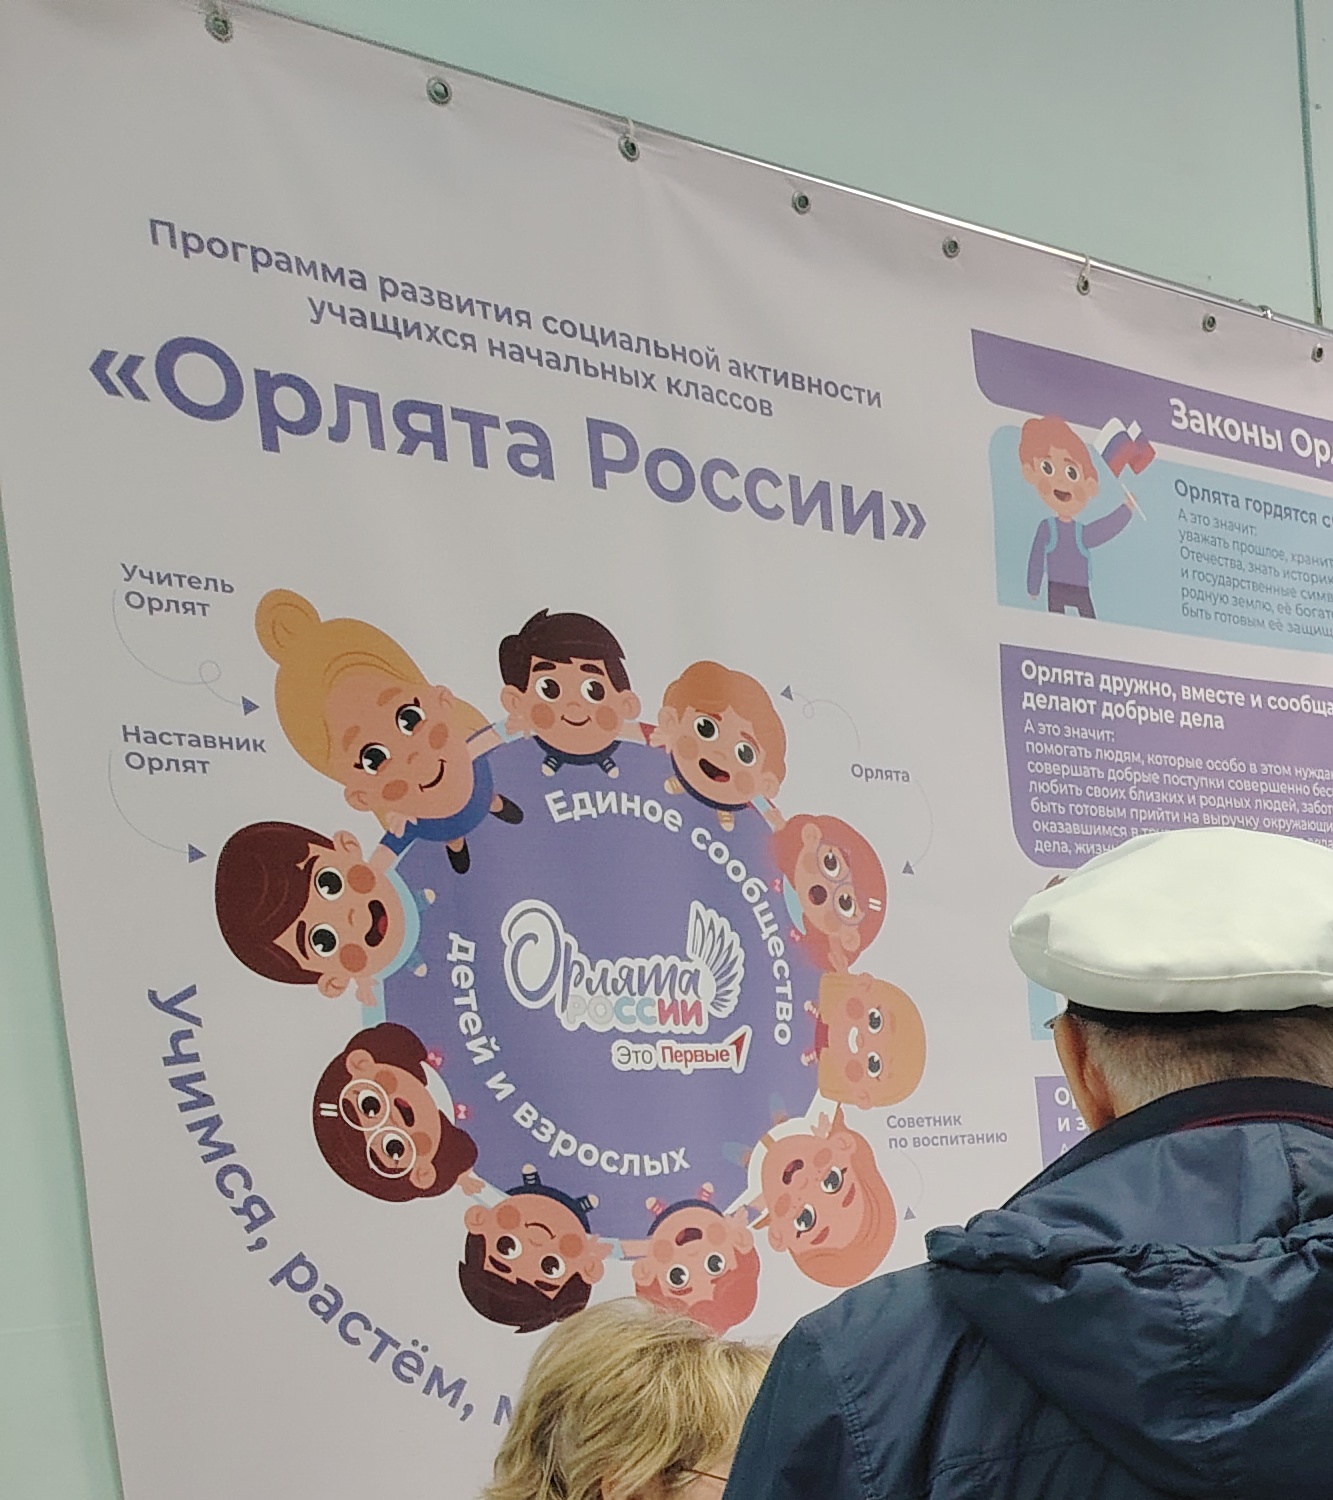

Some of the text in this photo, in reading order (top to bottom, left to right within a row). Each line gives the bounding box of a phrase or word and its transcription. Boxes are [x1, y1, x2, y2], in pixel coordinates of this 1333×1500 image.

[148, 216, 883, 410] Программа развития социальной активности
[307, 296, 774, 418] учащихся начальных классов
[88, 334, 928, 543] «Орлята России»
[1168, 397, 1284, 453] Законы
[1174, 479, 1240, 509] Орлята
[1244, 497, 1317, 525] гордятся
[1190, 512, 1210, 527] это
[1178, 529, 1230, 549] уважать
[1232, 540, 1288, 563] прошлое,
[1180, 546, 1246, 572] Отечества,
[1247, 562, 1280, 578] знать
[120, 562, 235, 595] Учитель
[1192, 569, 1298, 599] государственные
[124, 590, 211, 619] Орлят
[1181, 586, 1229, 606] родную
[1232, 596, 1275, 614] землю,
[1181, 602, 1212, 620] быть
[1214, 611, 1265, 628] готовым
[1021, 659, 1095, 687] Орлята
[1099, 673, 1177, 702] дружно,
[1181, 685, 1245, 707] вместе
[1250, 693, 1263, 709] и
[1021, 691, 1224, 730] делают добрые дела
[122, 724, 267, 754] Наставник
[1037, 722, 1115, 743] это значит:
[124, 752, 211, 776] Орлят
[850, 762, 910, 784] Орлята
[1025, 741, 1093, 759] помогать
[1094, 748, 1145, 766] людям,
[1147, 754, 1203, 771] которые
[1206, 758, 1247, 773] особо
[1261, 763, 1292, 776] этом
[1027, 760, 1105, 779] совершать
[1107, 766, 1160, 784] добрые
[1163, 773, 1224, 790] поступки
[1228, 779, 1310, 796] совершенно
[1029, 778, 1083, 797] любить
[1085, 785, 1125, 799] своих
[1128, 785, 1184, 805] близких
[1199, 795, 1251, 810] родных
[1254, 798, 1300, 814] людей,
[1030, 797, 1065, 815] быть
[1068, 803, 1127, 819] готовым
[1130, 806, 1180, 824] прийти
[1203, 814, 1260, 830] выручку
[1032, 820, 1127, 838] оказавшимся
[1033, 839, 1072, 855] дела,
[544, 789, 793, 1047] Единое сообщество
[508, 907, 701, 1015] Орлята
[566, 998, 704, 1026] РОССИИ
[447, 931, 691, 1179] детей и взрослых
[616, 1045, 731, 1067] Это Первые
[886, 1113, 963, 1130] Советник
[888, 1129, 1008, 1150] по воспитанию
[147, 983, 476, 1423] Учимся, растём,
